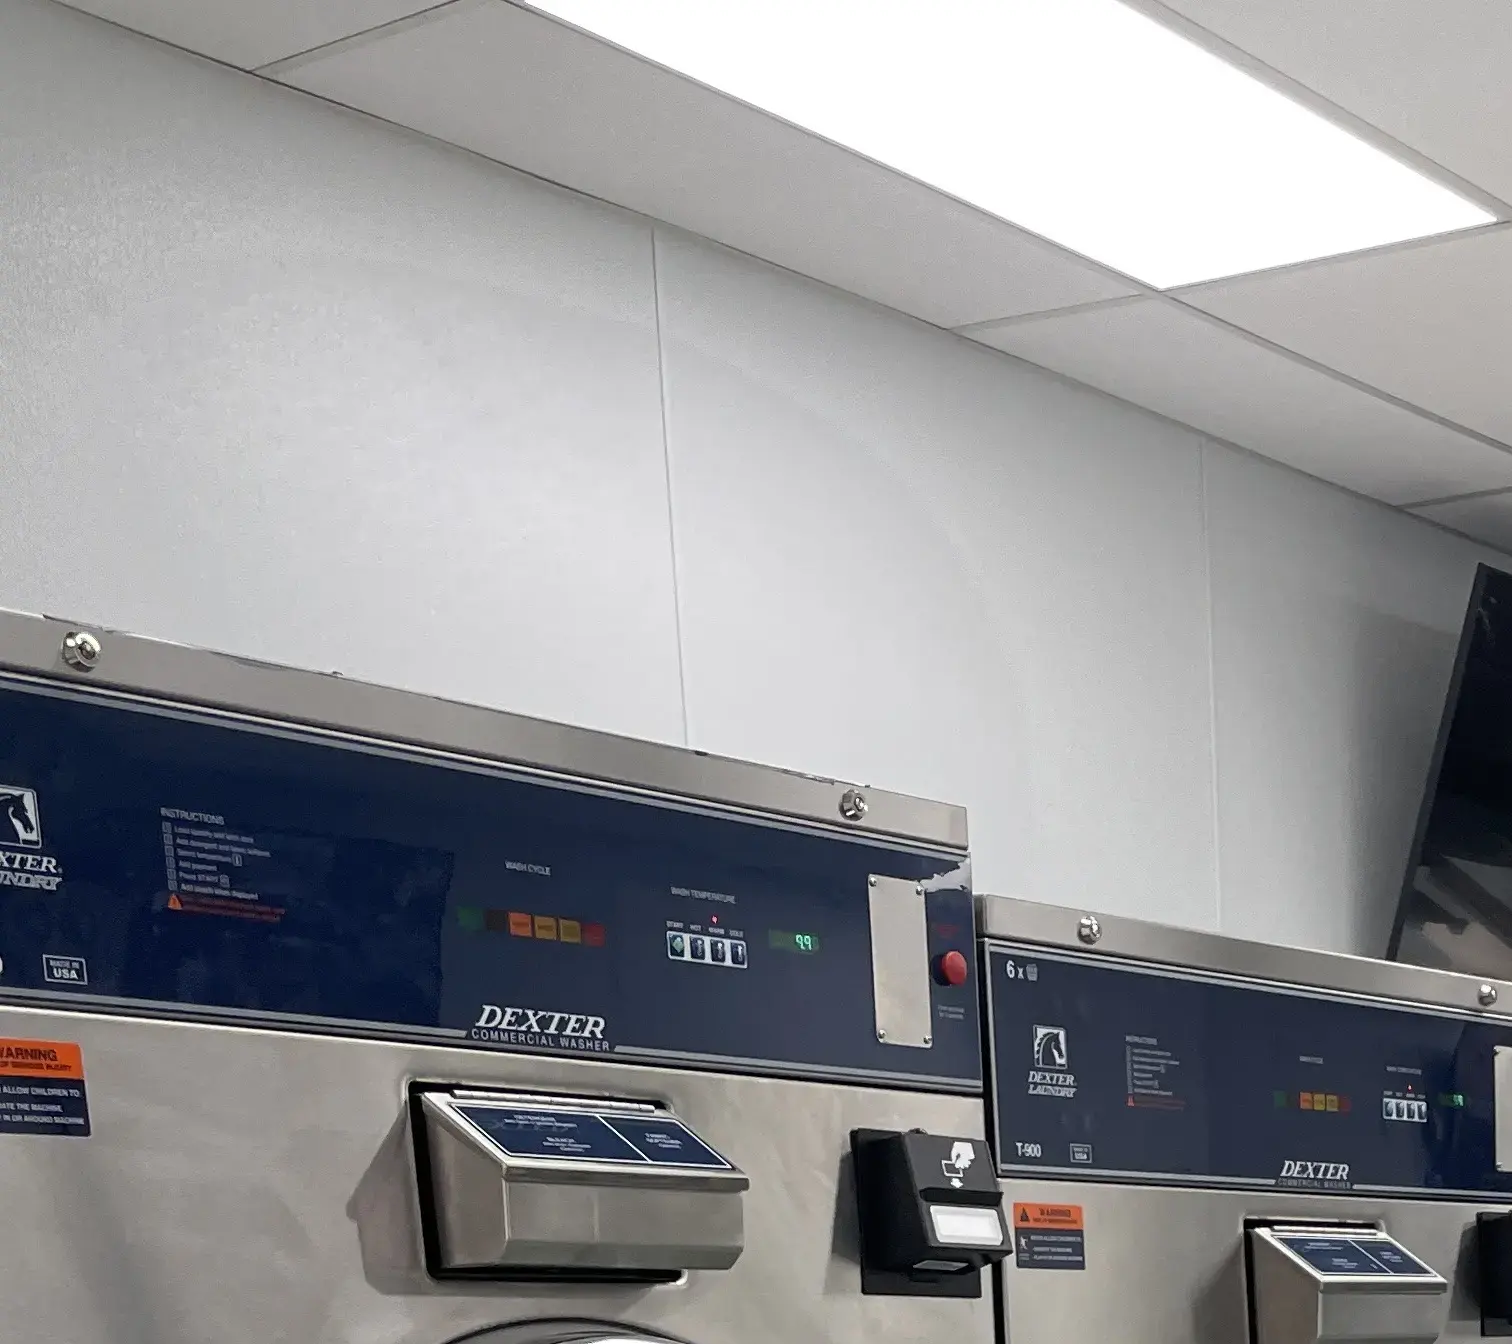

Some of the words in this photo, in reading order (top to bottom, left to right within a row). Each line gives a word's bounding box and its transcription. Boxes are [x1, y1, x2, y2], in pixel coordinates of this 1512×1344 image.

[527, 863, 551, 876] CYCLE
[53, 967, 78, 980] USA
[1006, 959, 1015, 979] 6
[474, 1004, 606, 1039] DEXTER
[471, 1028, 555, 1047] COMMERCIAL
[560, 1037, 610, 1051] WASHER
[1028, 1070, 1075, 1086] DEXTER
[1028, 1084, 1077, 1098] LAUNDRY
[1280, 1160, 1350, 1180] DEXTER
